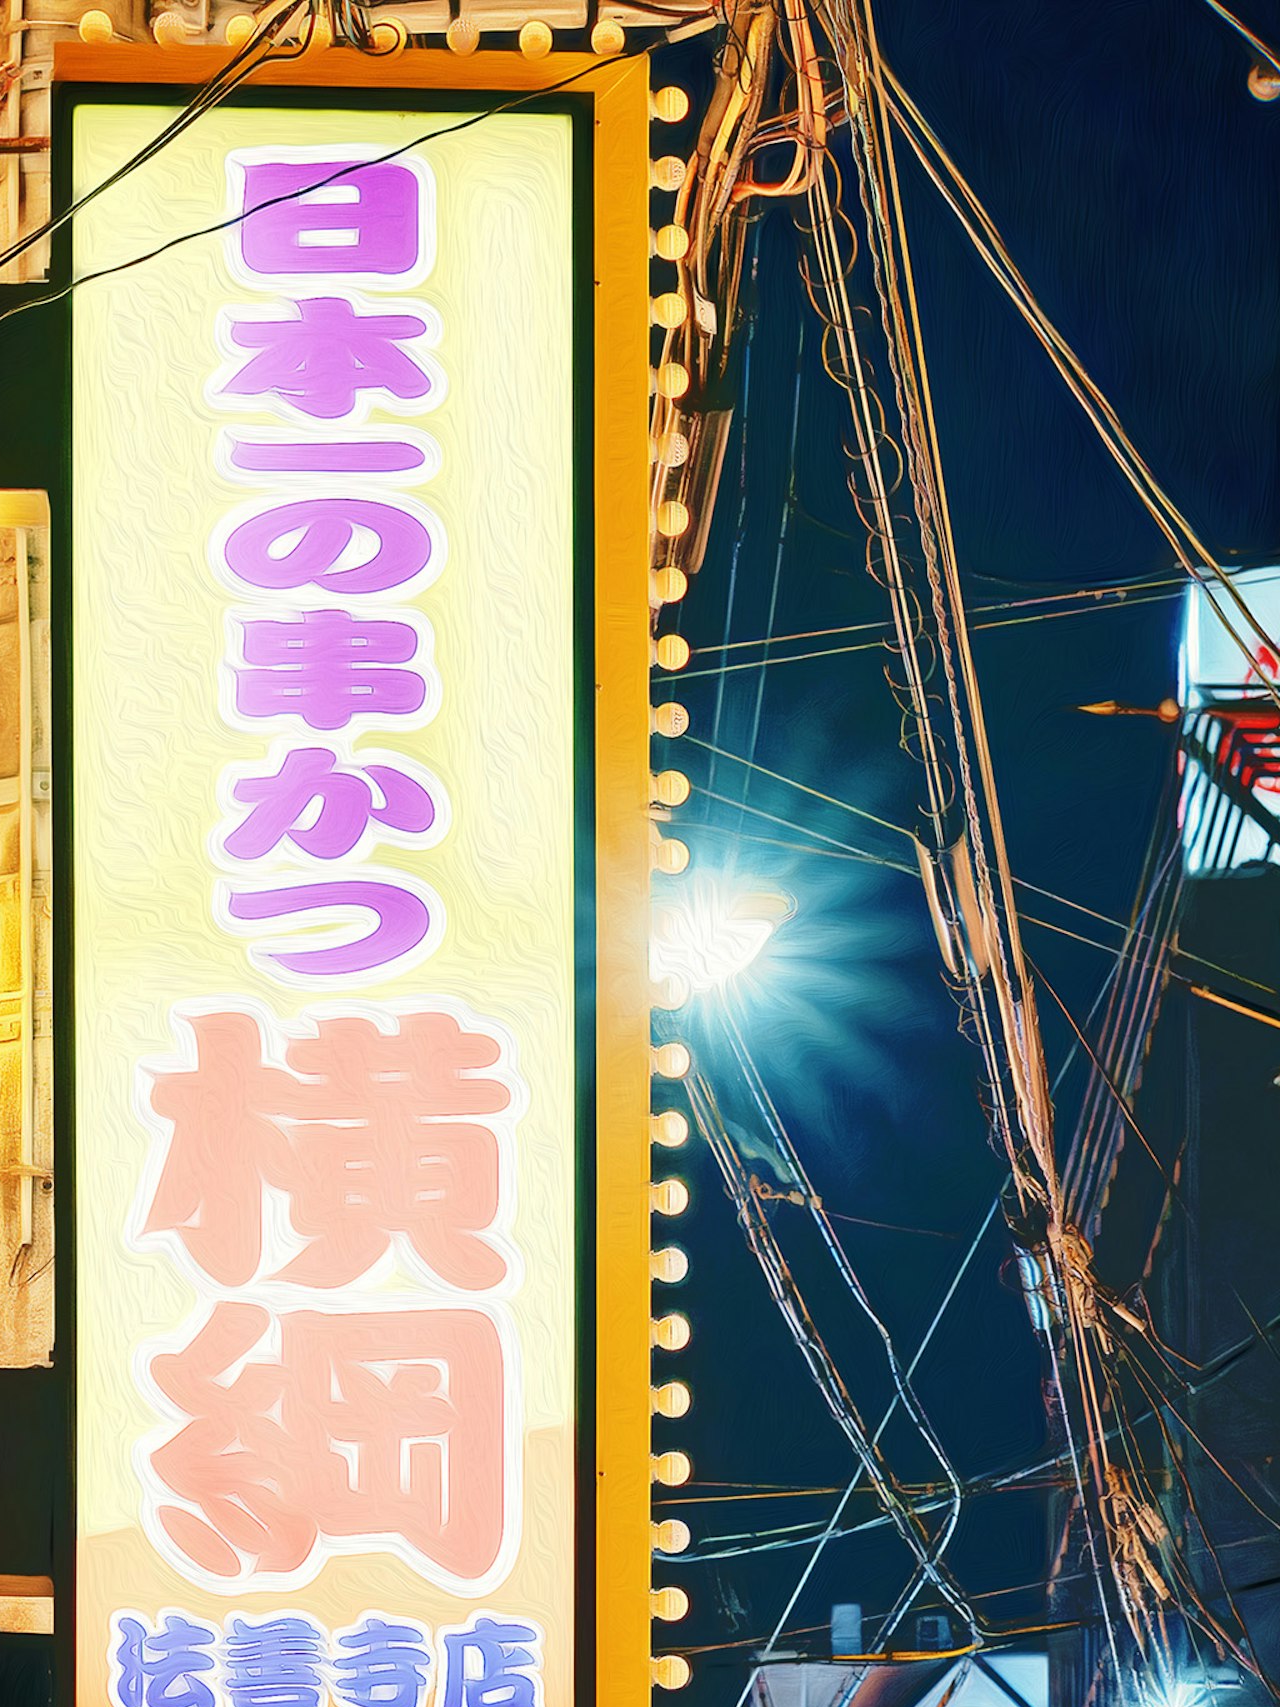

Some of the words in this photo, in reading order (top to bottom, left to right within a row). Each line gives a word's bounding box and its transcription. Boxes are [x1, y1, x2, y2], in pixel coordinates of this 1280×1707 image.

[212, 159, 436, 976] 日本一の串かつ
[142, 1010, 512, 1582] 横綱
